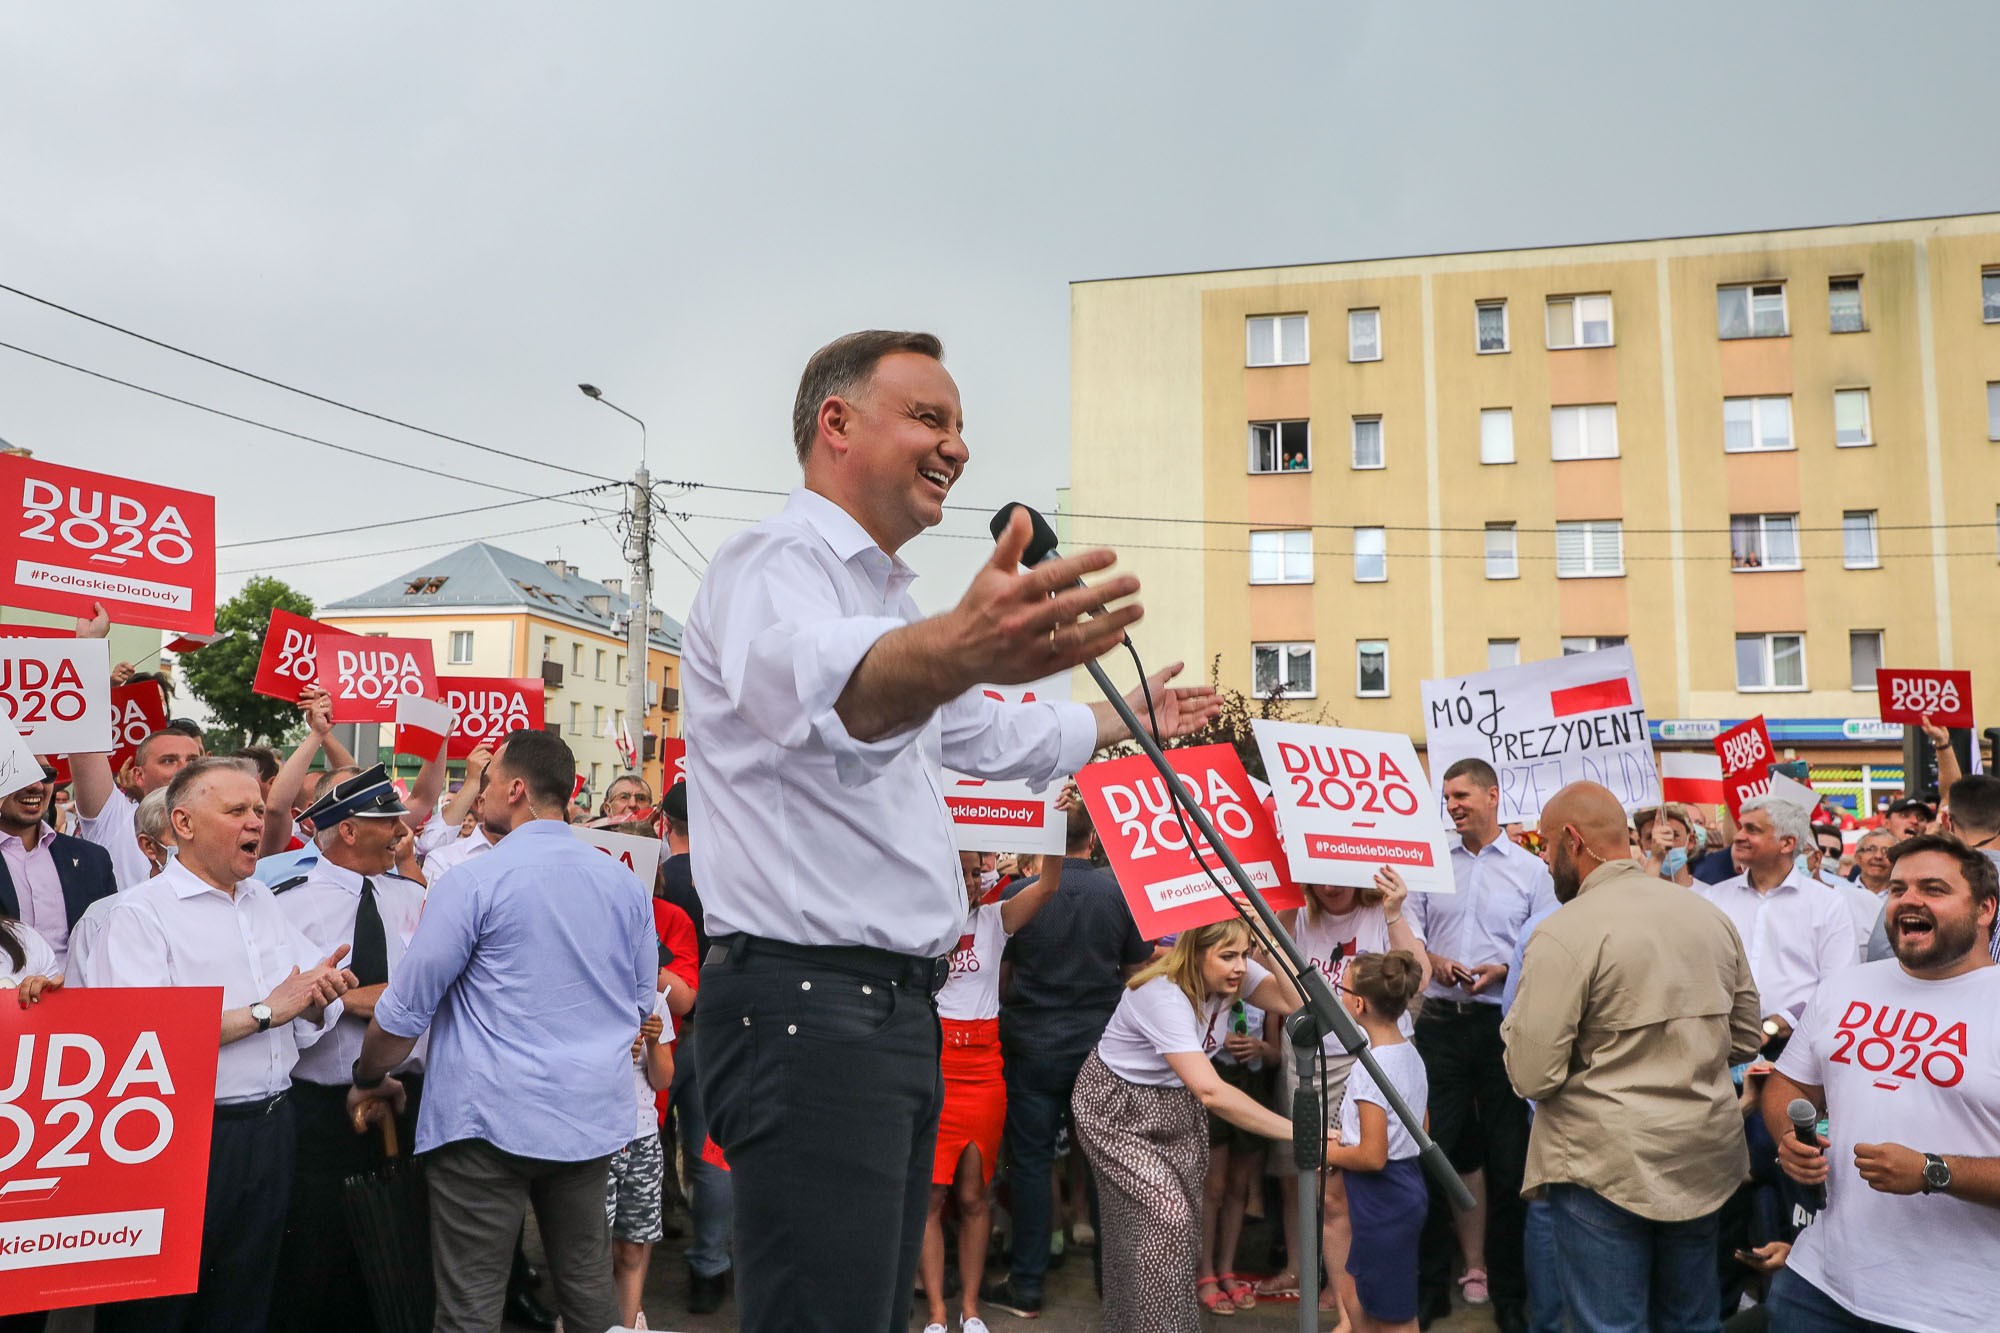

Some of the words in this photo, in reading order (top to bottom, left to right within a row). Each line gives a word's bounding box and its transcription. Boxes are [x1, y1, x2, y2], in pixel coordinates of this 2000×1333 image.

[22, 477, 192, 538] DUDA
[19, 509, 194, 565] 2020
[30, 569, 179, 603] #PodlaskieDlaDudy
[274, 651, 320, 685] 20
[338, 650, 421, 676] DUDA
[338, 674, 424, 700] 2020
[447, 690, 529, 714] DUDA
[1891, 694, 1960, 713] 2020
[1892, 678, 1959, 697] DUDA
[450, 713, 530, 737] 2020
[1432, 681, 1505, 736] MÓJ
[1490, 709, 1645, 763] PREZYDENT
[1722, 727, 1762, 763] DUDA
[1277, 742, 1410, 784] DUDA
[1728, 741, 1766, 773] 2020
[1101, 768, 1241, 824] DUDA
[1290, 775, 1419, 816] 2020
[1121, 802, 1254, 860] 2020
[1315, 840, 1424, 862] #PodlaskieDlaDudy
[1838, 1001, 1967, 1057] DUDA
[1829, 1029, 1965, 1088] 2020
